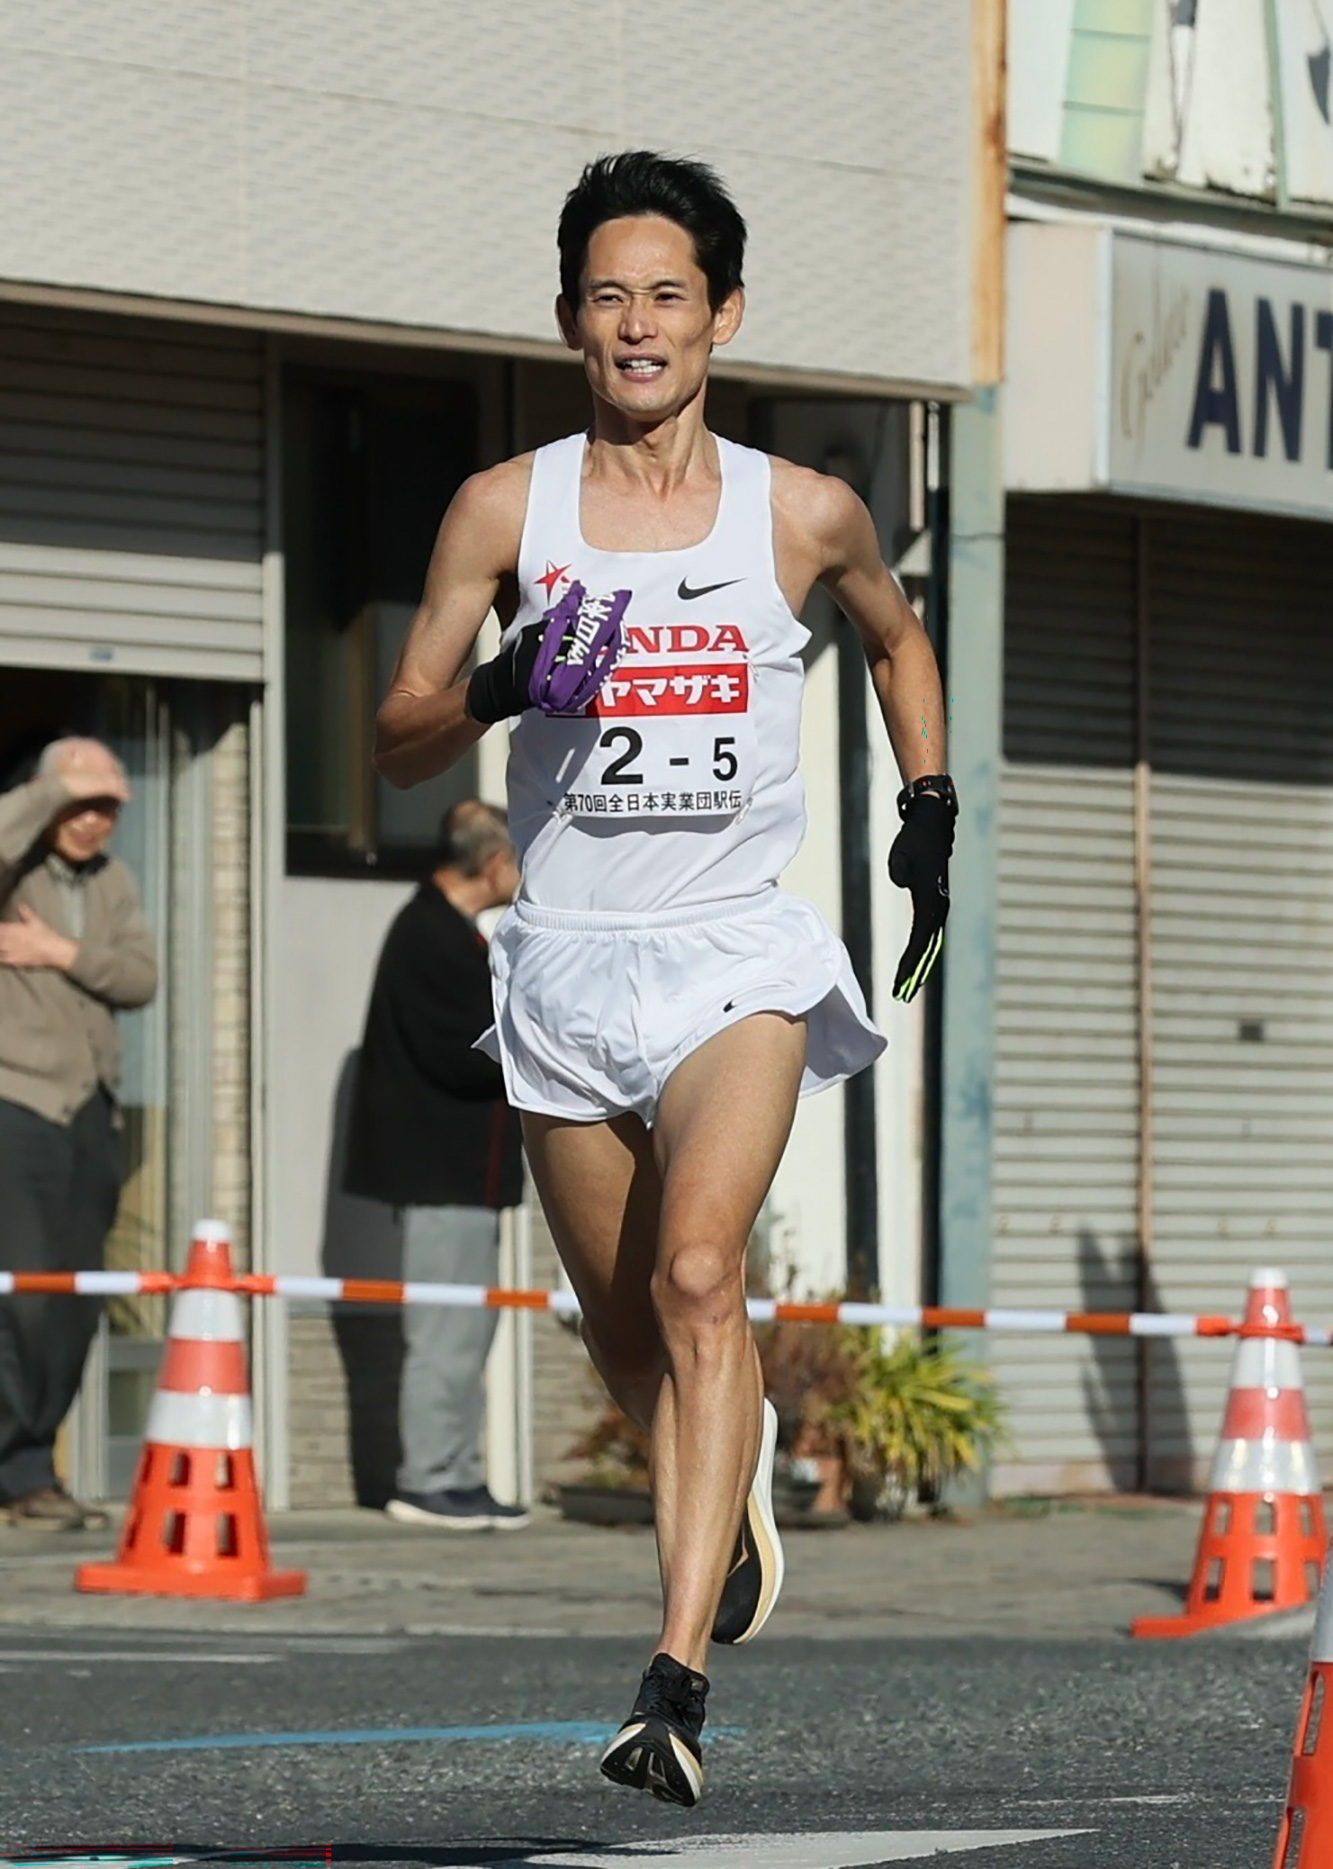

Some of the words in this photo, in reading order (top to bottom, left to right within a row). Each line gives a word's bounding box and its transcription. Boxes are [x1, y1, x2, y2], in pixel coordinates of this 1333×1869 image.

[626, 625, 749, 653] NDA
[601, 674, 740, 707] ヤマザキ
[600, 727, 643, 785] 2
[712, 737, 738, 781] 5
[564, 790, 742, 812] 第70回全日本実業団駅伝
